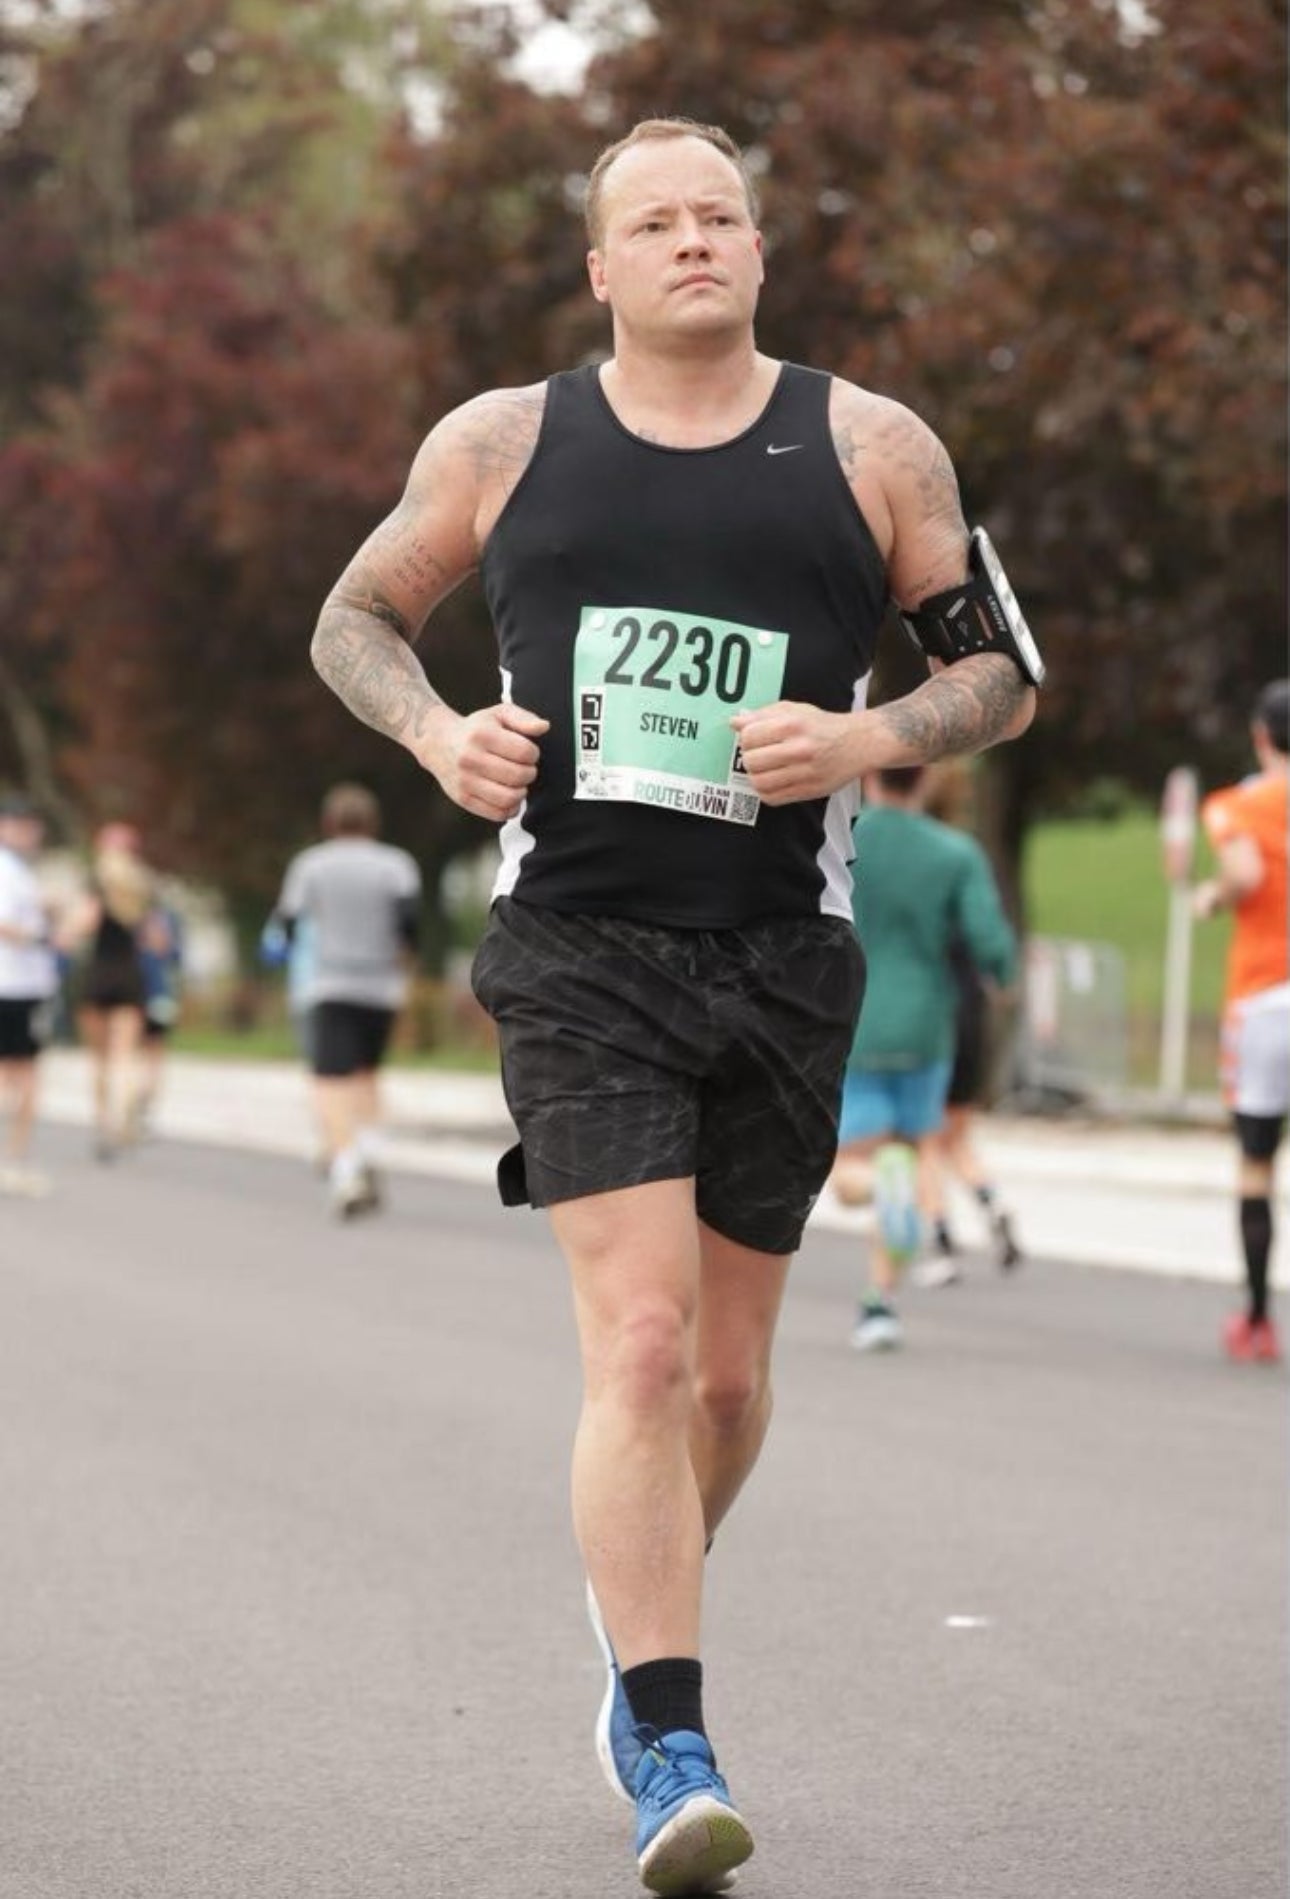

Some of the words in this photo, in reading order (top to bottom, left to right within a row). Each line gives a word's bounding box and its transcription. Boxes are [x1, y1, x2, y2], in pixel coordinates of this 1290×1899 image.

[604, 616, 750, 704] 2230
[640, 711, 699, 740] STEVEN
[635, 781, 684, 807] ROUTE
[702, 795, 728, 816] VIN
